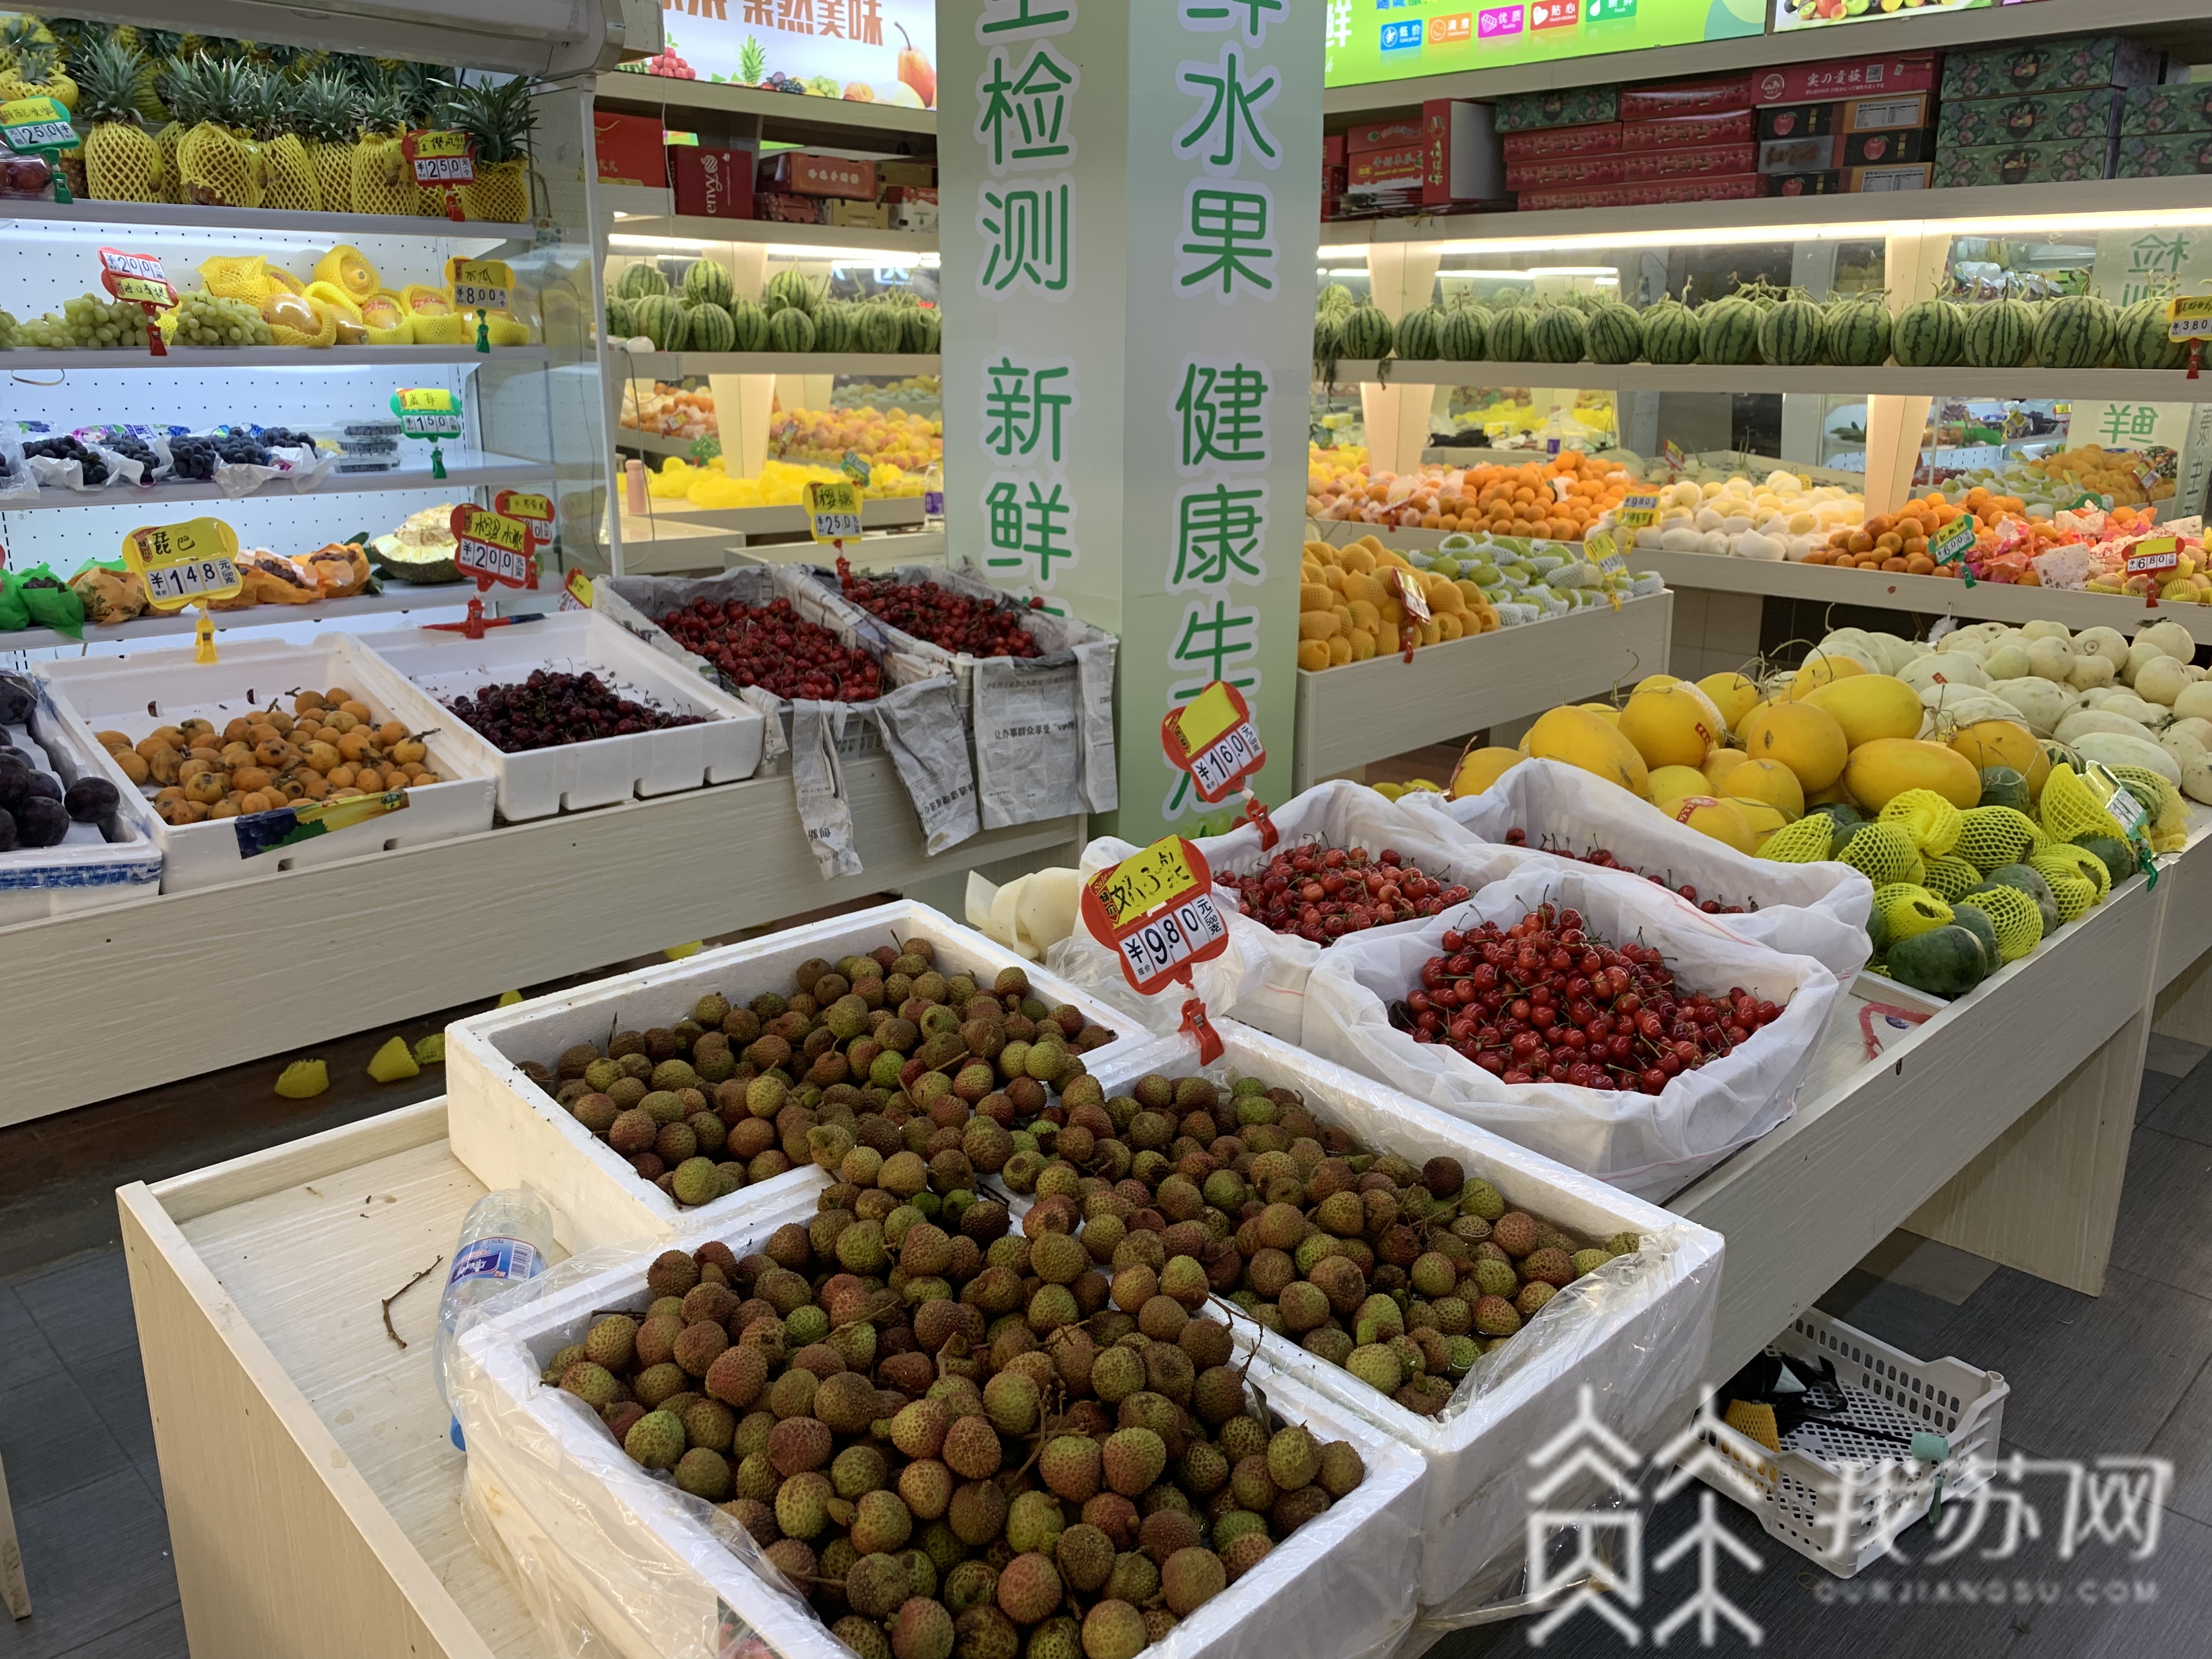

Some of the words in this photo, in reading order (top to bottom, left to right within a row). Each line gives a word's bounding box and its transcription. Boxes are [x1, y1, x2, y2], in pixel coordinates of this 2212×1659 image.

[1498, 10, 1521, 25] 优质
[1551, 2, 1576, 16] 贴心
[1400, 24, 1420, 37] 低价
[1448, 18, 1470, 31] 满意
[706, 172, 723, 214] envy
[465, 267, 494, 285] 木瓜
[985, 357, 1072, 617] 新鲜
[1169, 363, 1268, 811] 健康生
[1195, 734, 1244, 780] ¥16.0
[1099, 890, 1119, 916] 特价
[1125, 907, 1199, 964] ¥9.80
[1197, 898, 1222, 935] 元/500克
